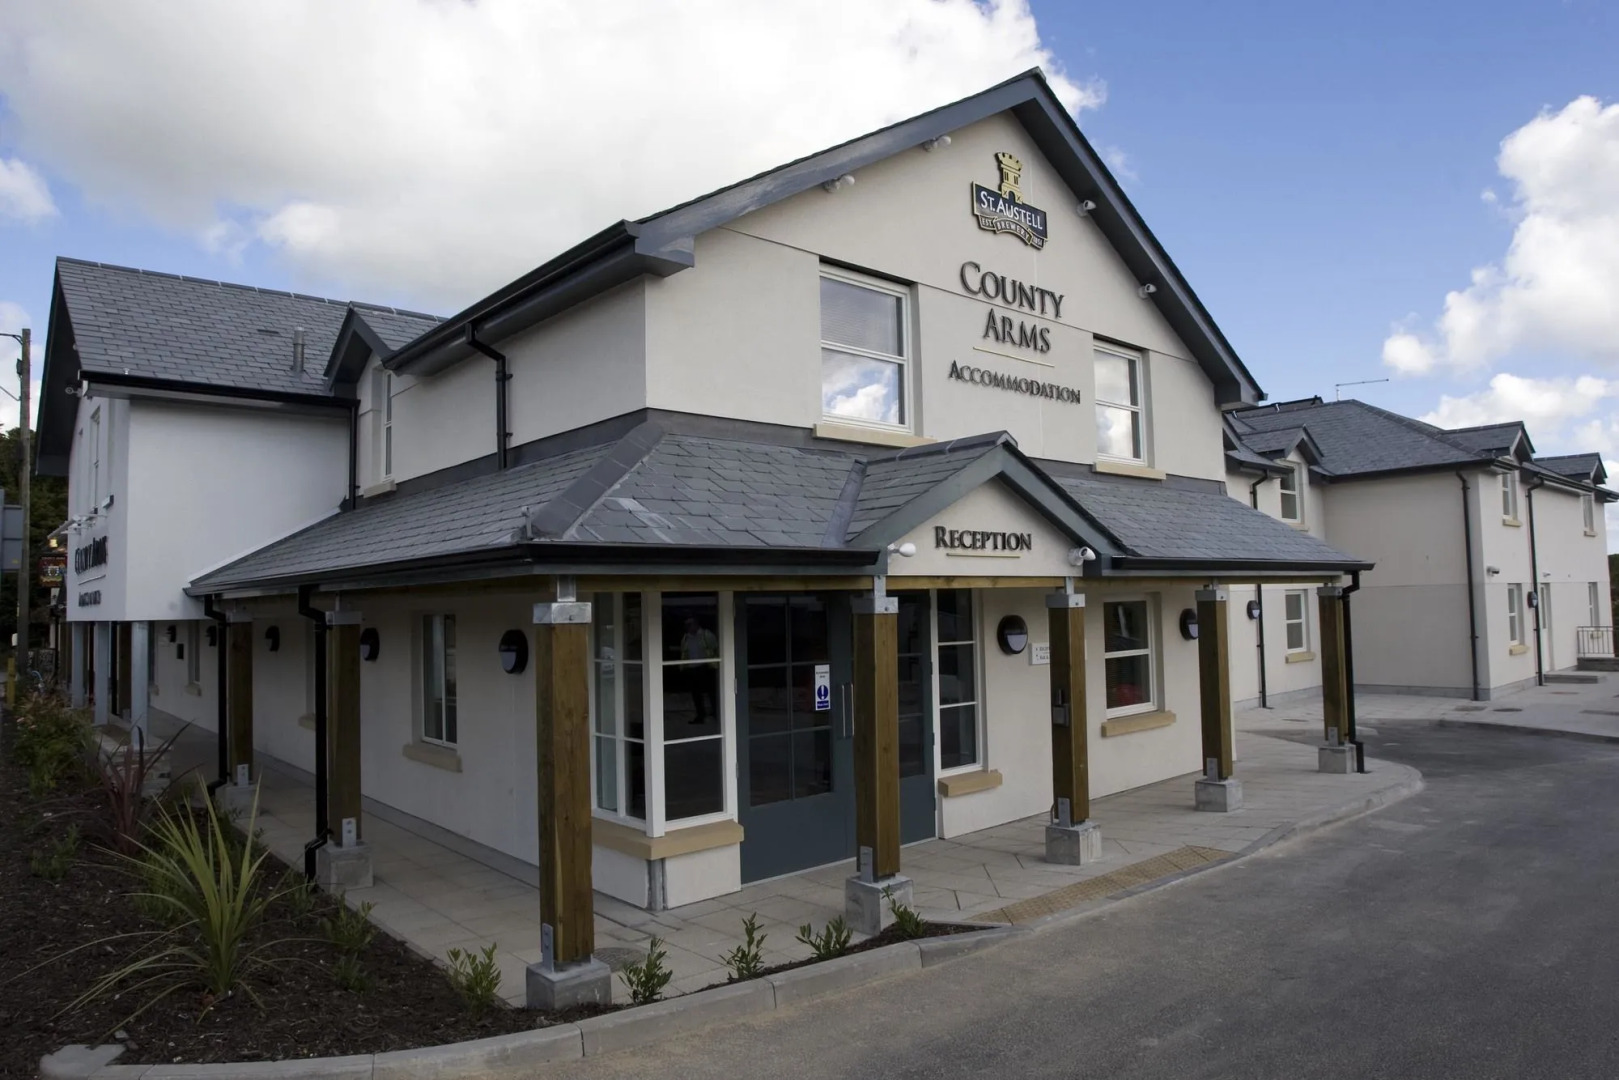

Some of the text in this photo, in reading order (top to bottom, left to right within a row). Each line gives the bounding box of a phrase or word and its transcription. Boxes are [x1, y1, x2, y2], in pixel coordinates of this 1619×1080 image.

[997, 221, 1029, 240] BREWERY
[960, 261, 1064, 319] COUNTY
[983, 307, 1051, 353] ARMS
[948, 360, 1081, 404] ACCOMMODATION
[934, 526, 1032, 551] RECEPTION
